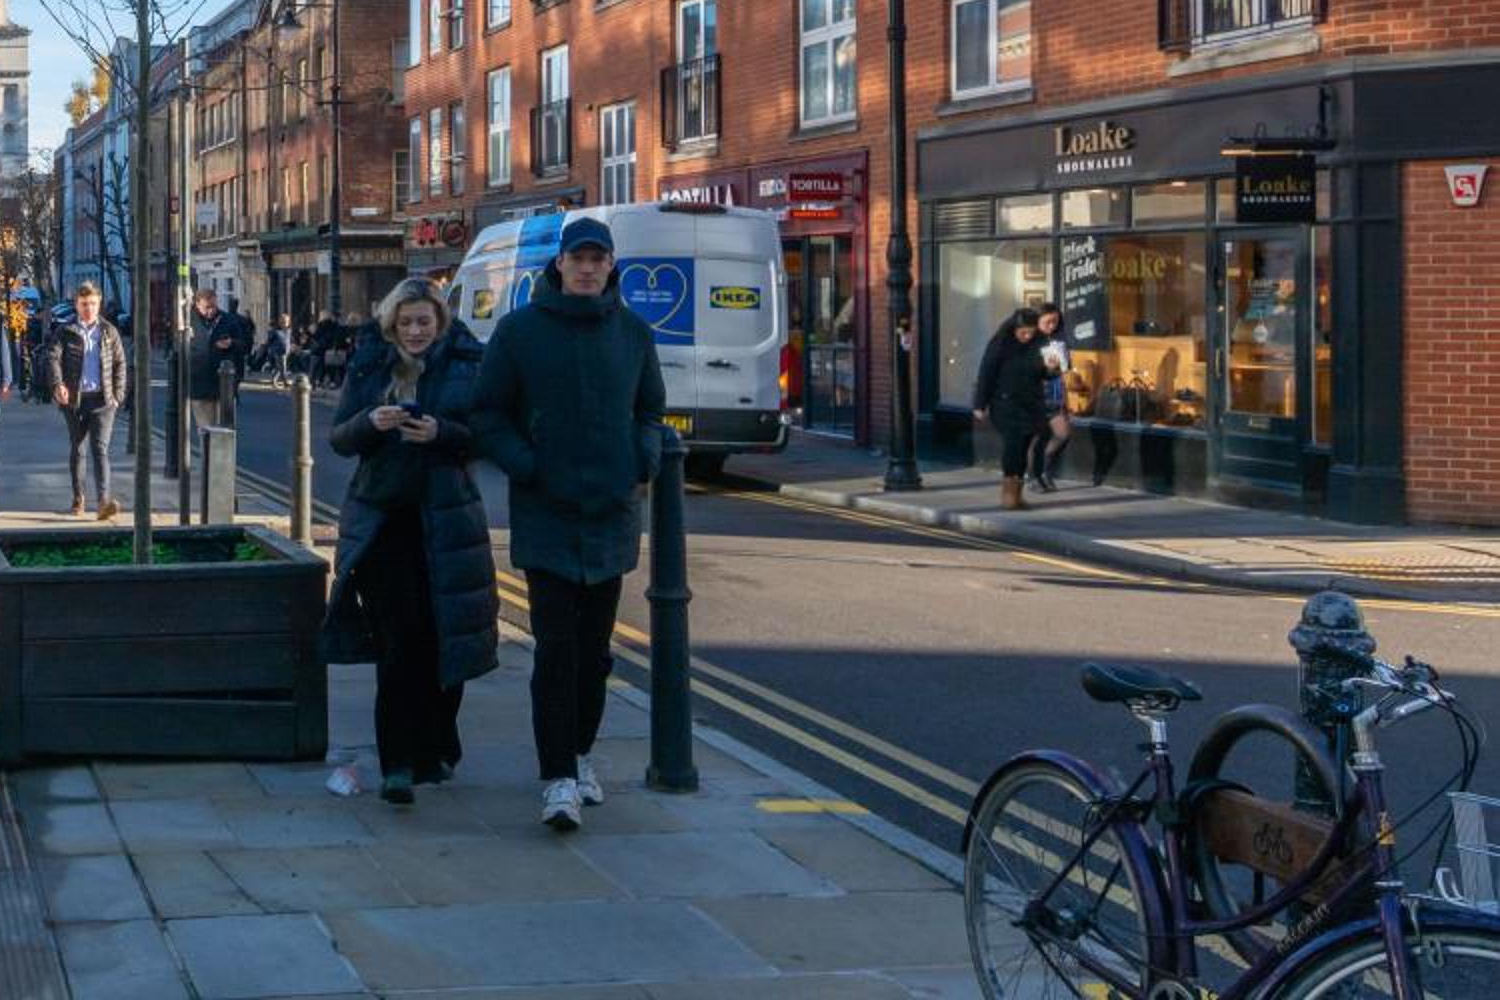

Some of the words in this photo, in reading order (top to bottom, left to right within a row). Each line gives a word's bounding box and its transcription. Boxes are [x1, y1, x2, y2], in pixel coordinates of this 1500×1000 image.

[1055, 121, 1128, 155] Loake
[1057, 155, 1133, 174] SHOEMAKERS
[791, 179, 840, 191] TORTILLA
[1243, 174, 1312, 195] Loake
